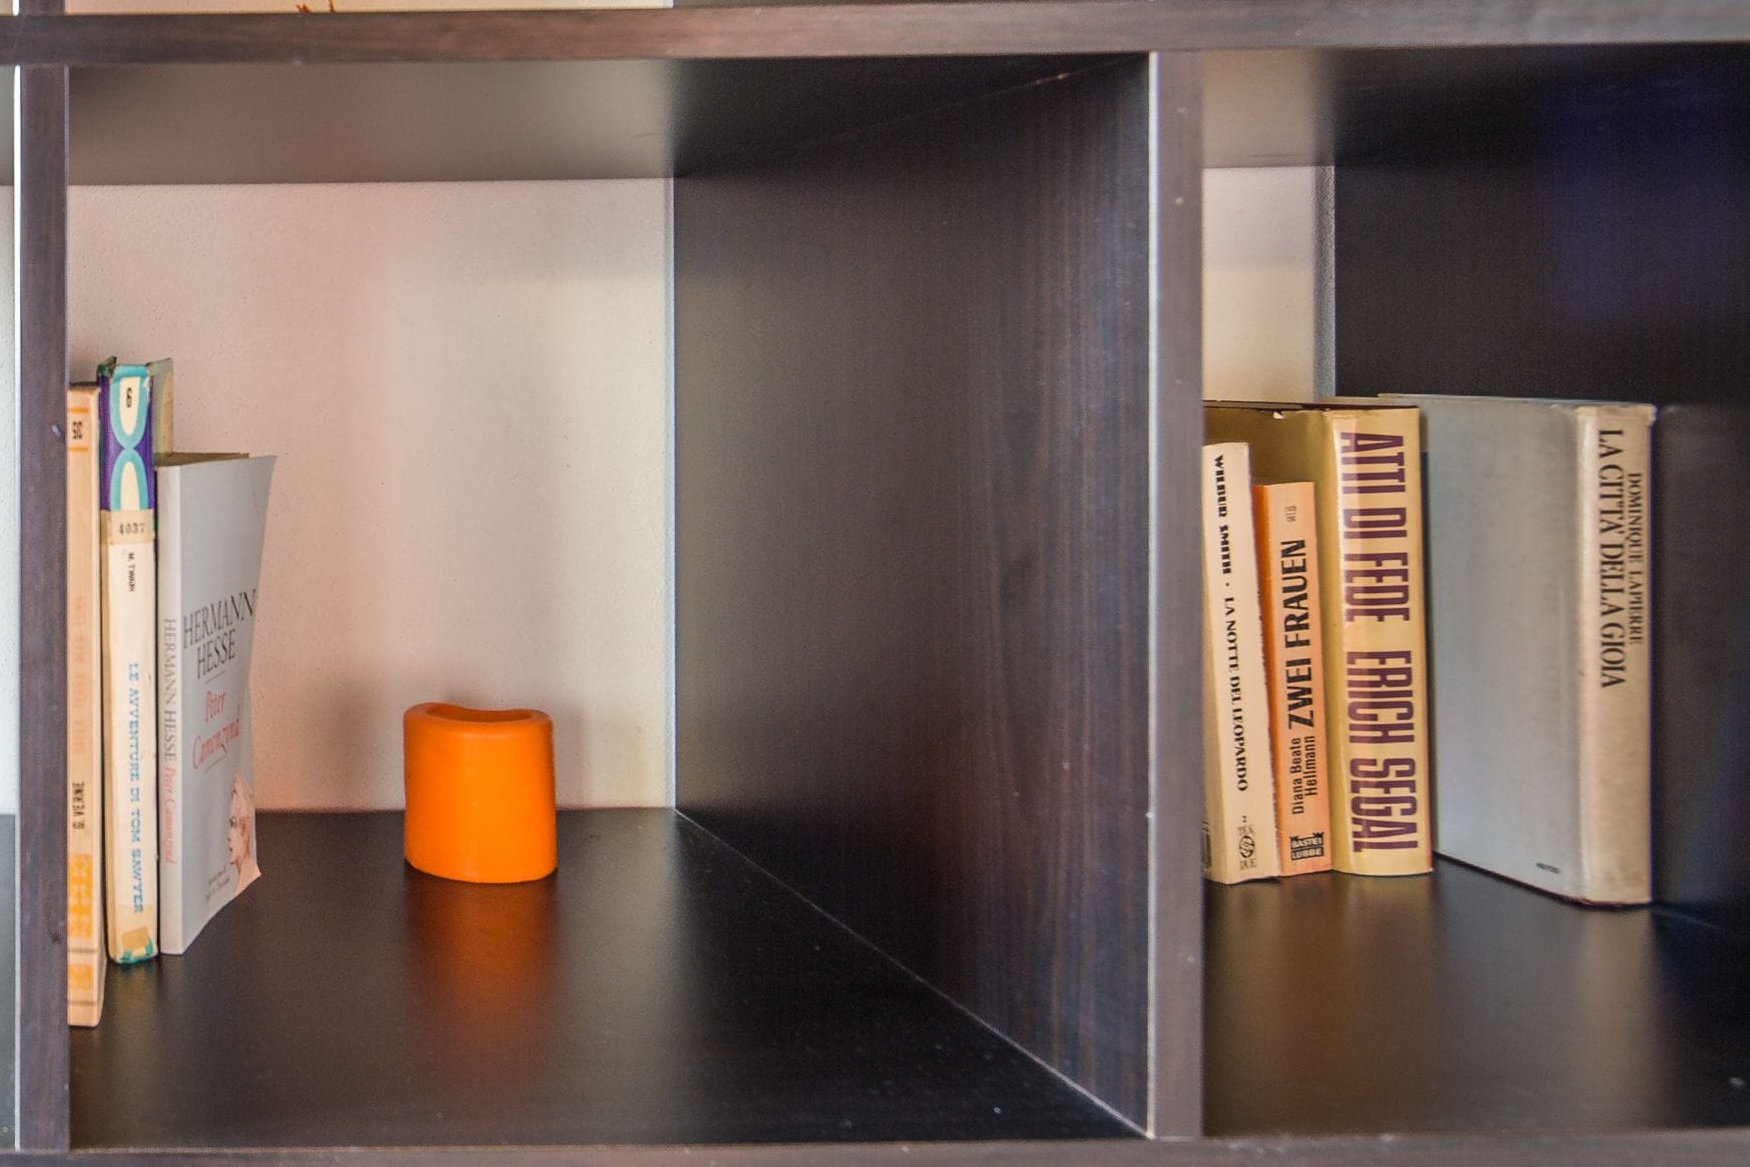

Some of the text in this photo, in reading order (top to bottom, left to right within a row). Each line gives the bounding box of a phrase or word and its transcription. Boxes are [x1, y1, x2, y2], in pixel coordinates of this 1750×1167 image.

[1598, 430, 1624, 459] LA
[1600, 543, 1625, 617] DELLA
[1625, 473, 1644, 645] DOMINIQUE LAPIERRE
[183, 588, 256, 650] HERMANN
[197, 628, 236, 679] HESSE
[1214, 454, 1248, 792] WILBUR SMITH LA NOTTE DEL LEOPARDO
[1280, 539, 1315, 730] ZWEI FRAUEN
[1340, 432, 1418, 853] ATTI DI FEDE ERICH SEGAL
[164, 619, 176, 705] HERMANN
[1601, 622, 1626, 688] GIOIA
[164, 710, 177, 763] HESSE
[1303, 735, 1318, 797] Hellmann
[72, 782, 85, 817] VERNE
[128, 663, 143, 914] LE AVVENTURE DI TOM SAWYER
[1289, 737, 1305, 815] Diana Beate
[1291, 837, 1323, 848] BASTEI
